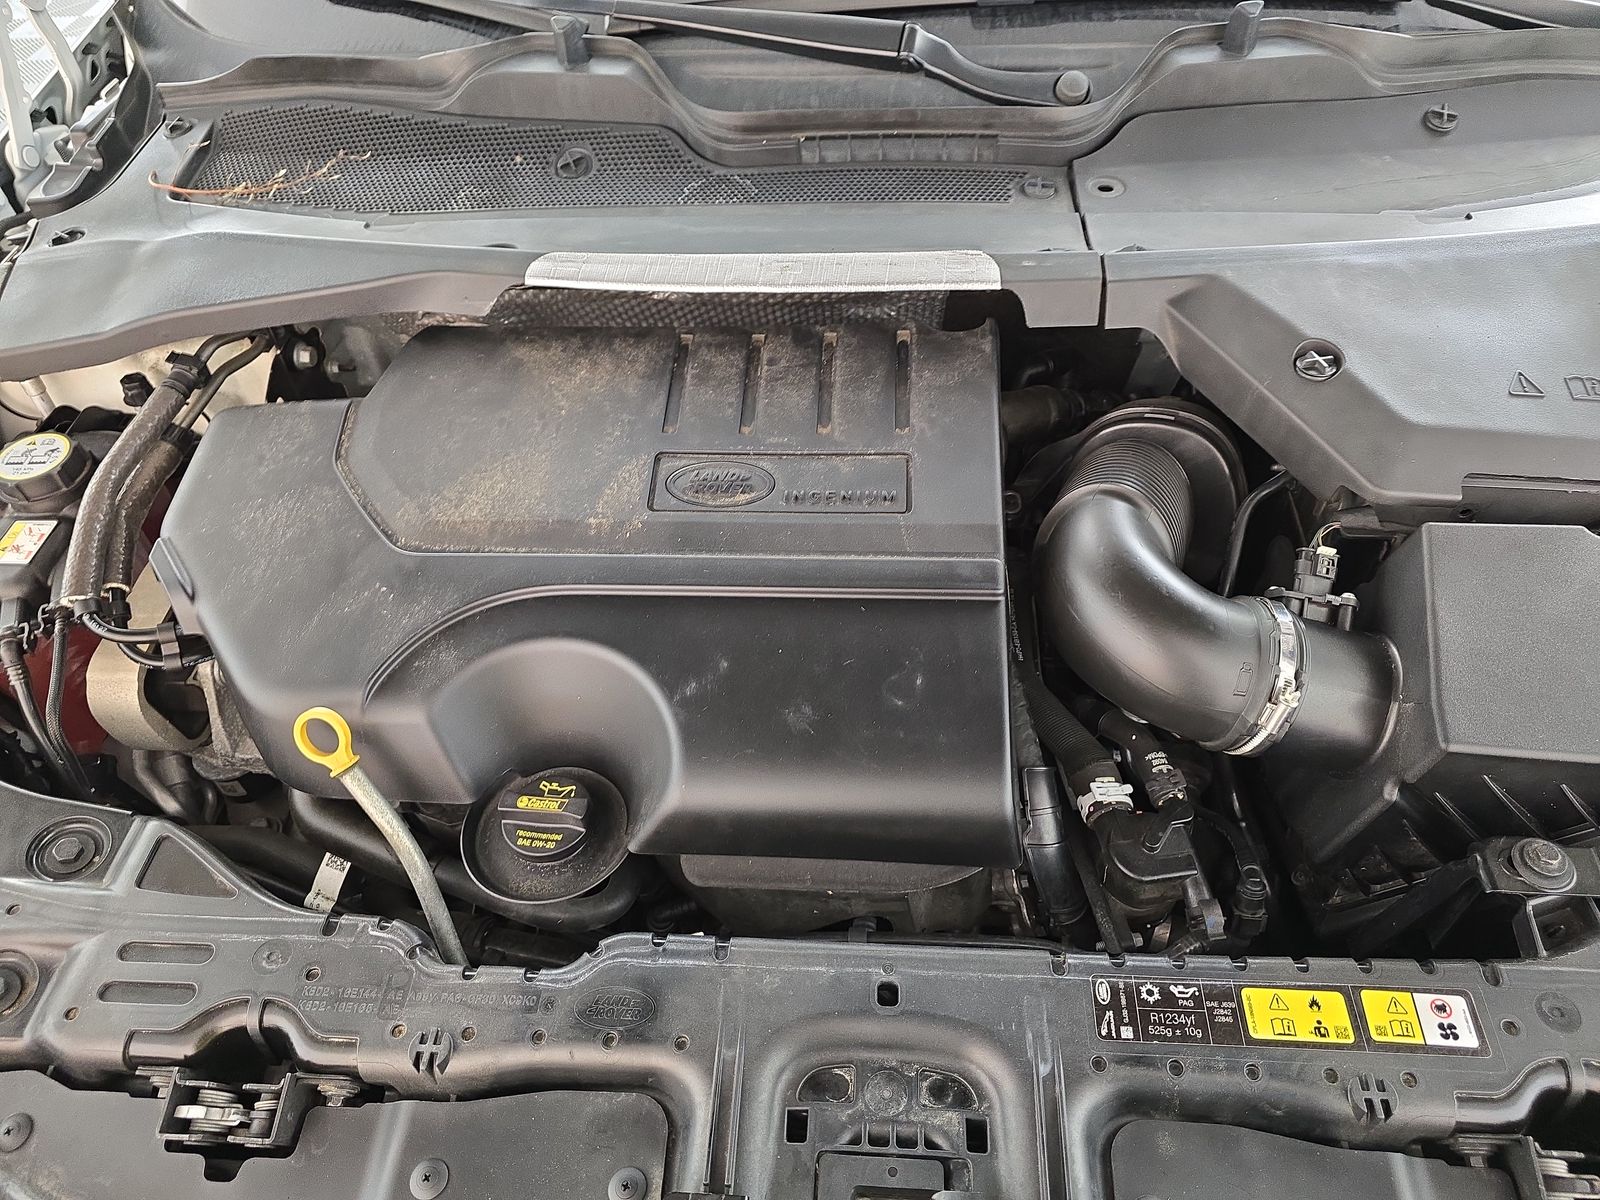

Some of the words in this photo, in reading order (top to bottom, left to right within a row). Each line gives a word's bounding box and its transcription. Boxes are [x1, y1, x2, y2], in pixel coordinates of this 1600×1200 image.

[781, 490, 898, 504] INGENIUM
[527, 798, 560, 809] Castrol
[516, 830, 563, 841] recommended
[517, 837, 531, 847] SAE
[532, 840, 556, 849] 0W-20
[1213, 1008, 1232, 1016] J2842
[1150, 1012, 1196, 1028] R1234yf
[1148, 1025, 1173, 1037] 525g
[1184, 1027, 1203, 1038] 10g
